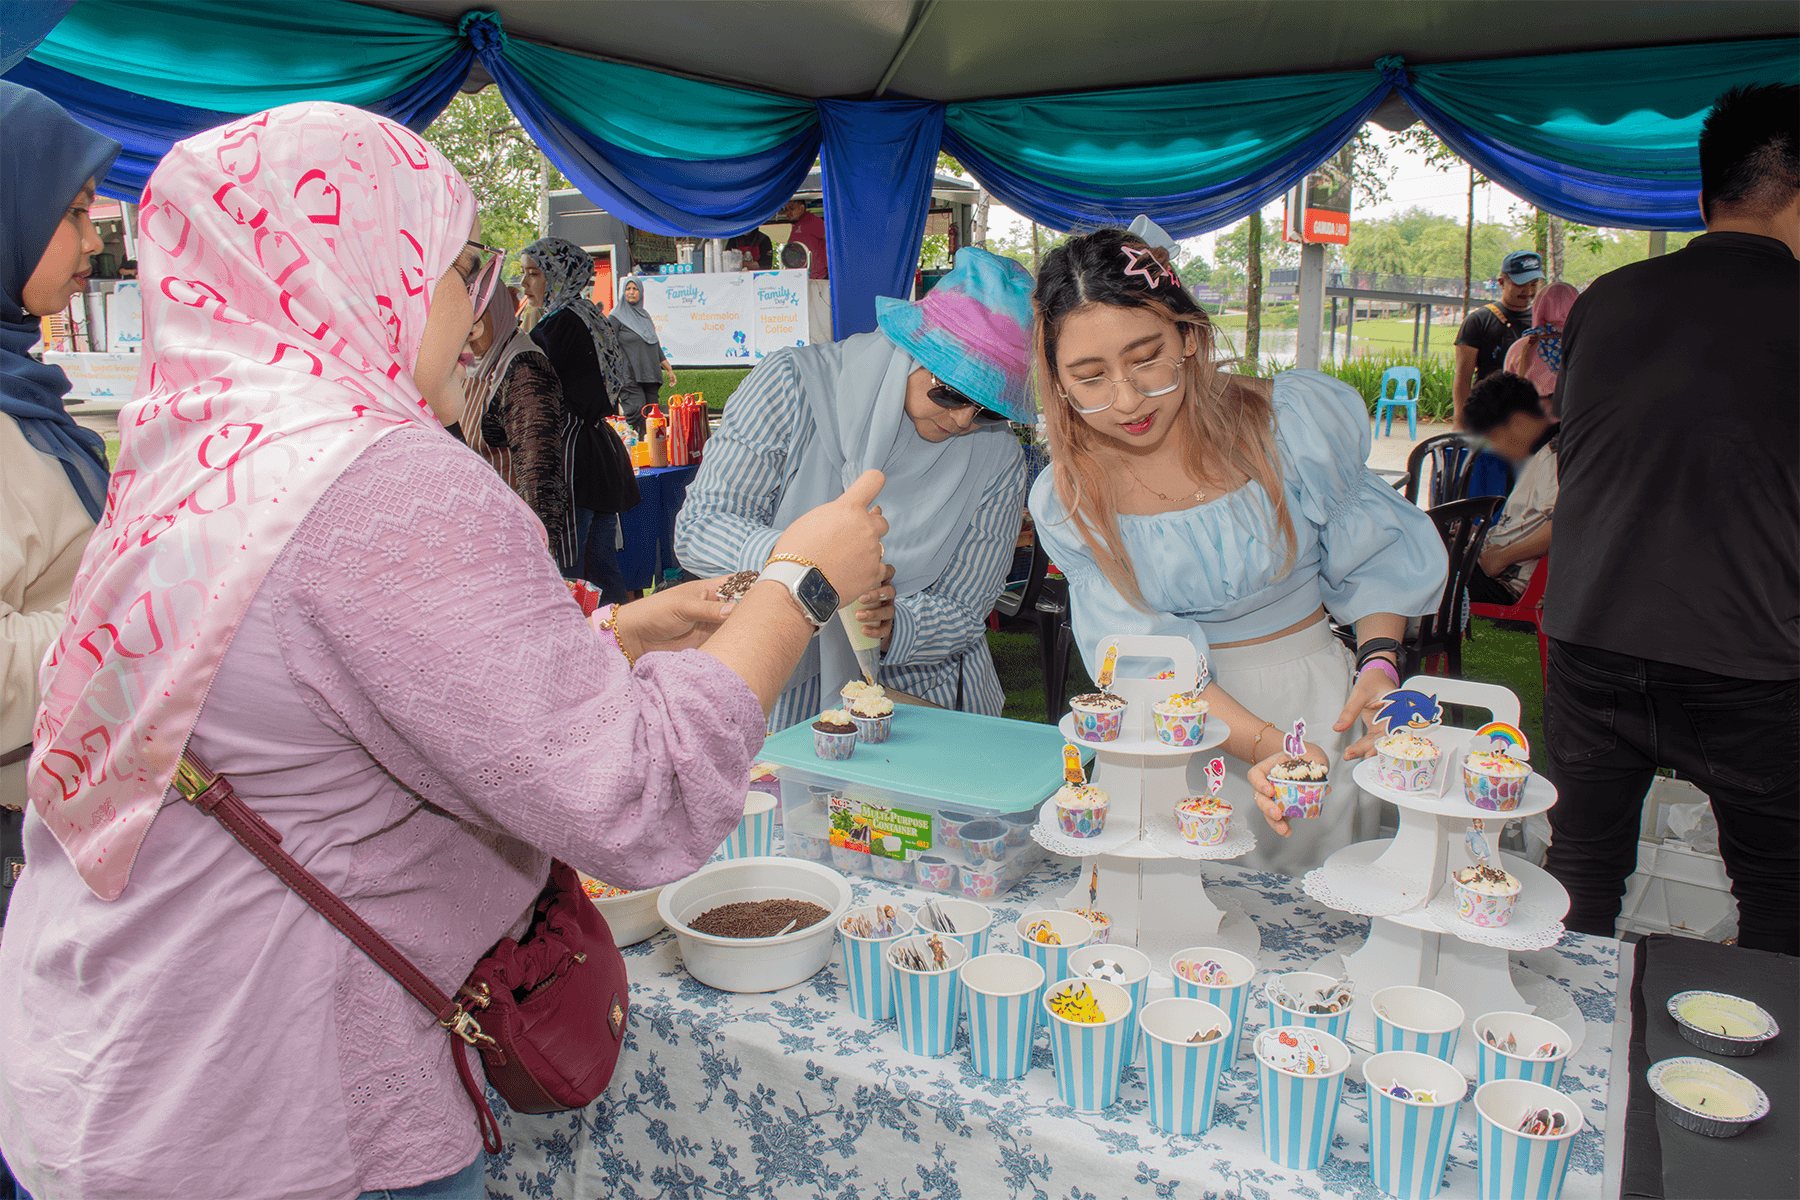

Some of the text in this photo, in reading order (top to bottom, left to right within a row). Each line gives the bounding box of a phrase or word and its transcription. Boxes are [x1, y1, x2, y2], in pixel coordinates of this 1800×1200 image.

[666, 284, 698, 300] Family
[757, 285, 790, 301] Family
[774, 298, 786, 306] Day
[690, 311, 740, 321] Watermelon
[761, 313, 798, 324] Hazelnut
[702, 322, 725, 331] Juice
[765, 324, 793, 334] Coffee
[872, 818, 918, 837] CONTAINER
